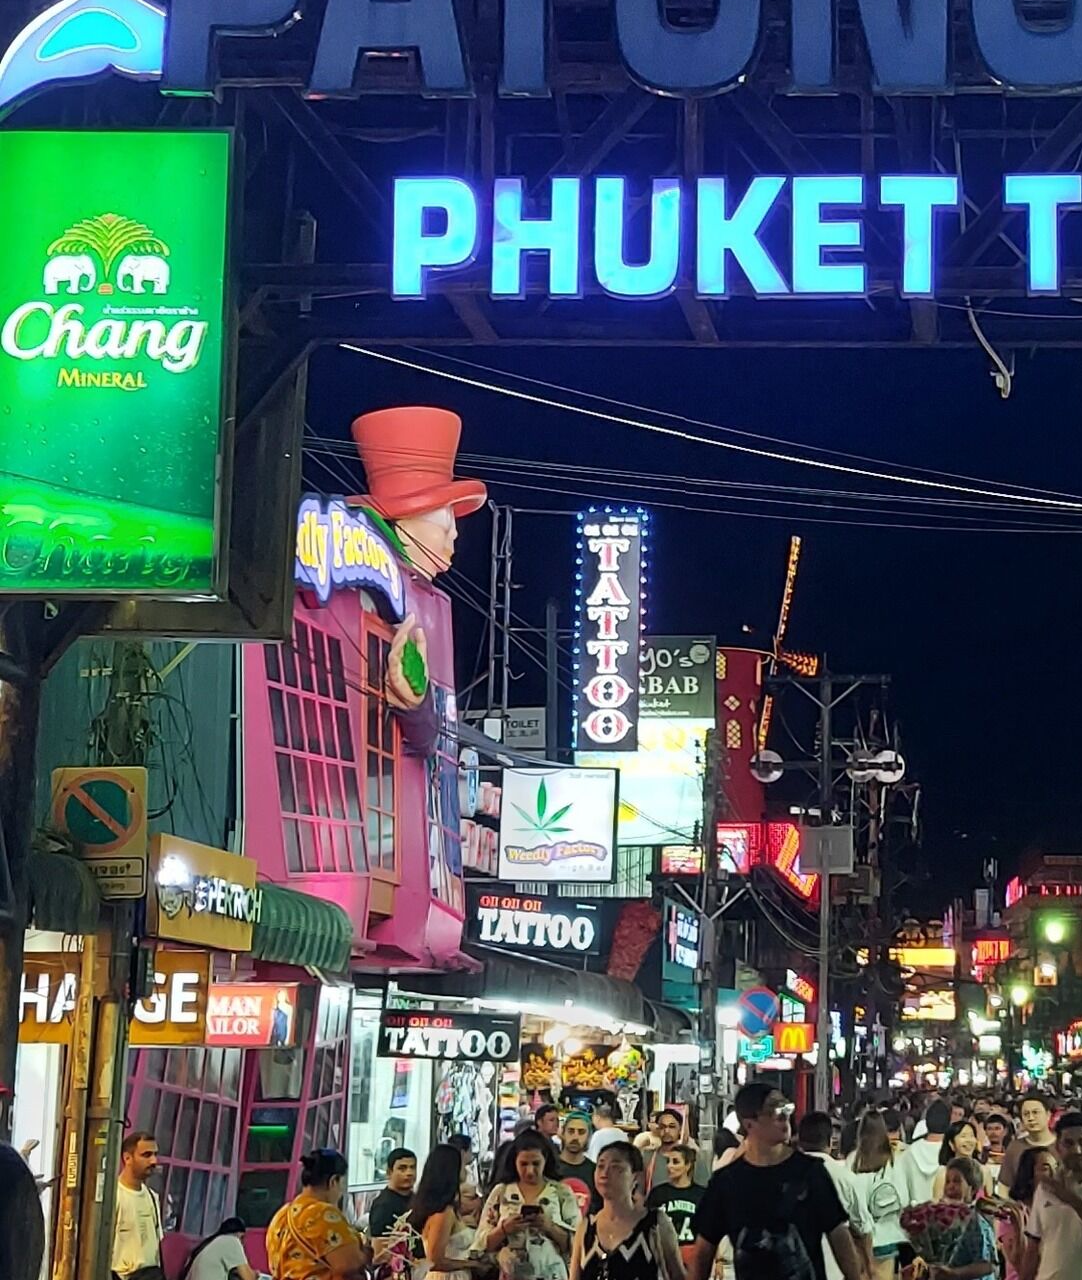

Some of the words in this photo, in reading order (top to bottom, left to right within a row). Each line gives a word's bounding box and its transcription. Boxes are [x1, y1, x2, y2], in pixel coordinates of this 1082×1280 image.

[390, 173, 959, 300] PHUKET
[1, 301, 208, 373] Chang
[57, 367, 147, 391] MINERAL
[582, 538, 634, 744] TATTOO
[478, 907, 595, 951] TATTOO
[385, 1026, 511, 1058] TATTOO
